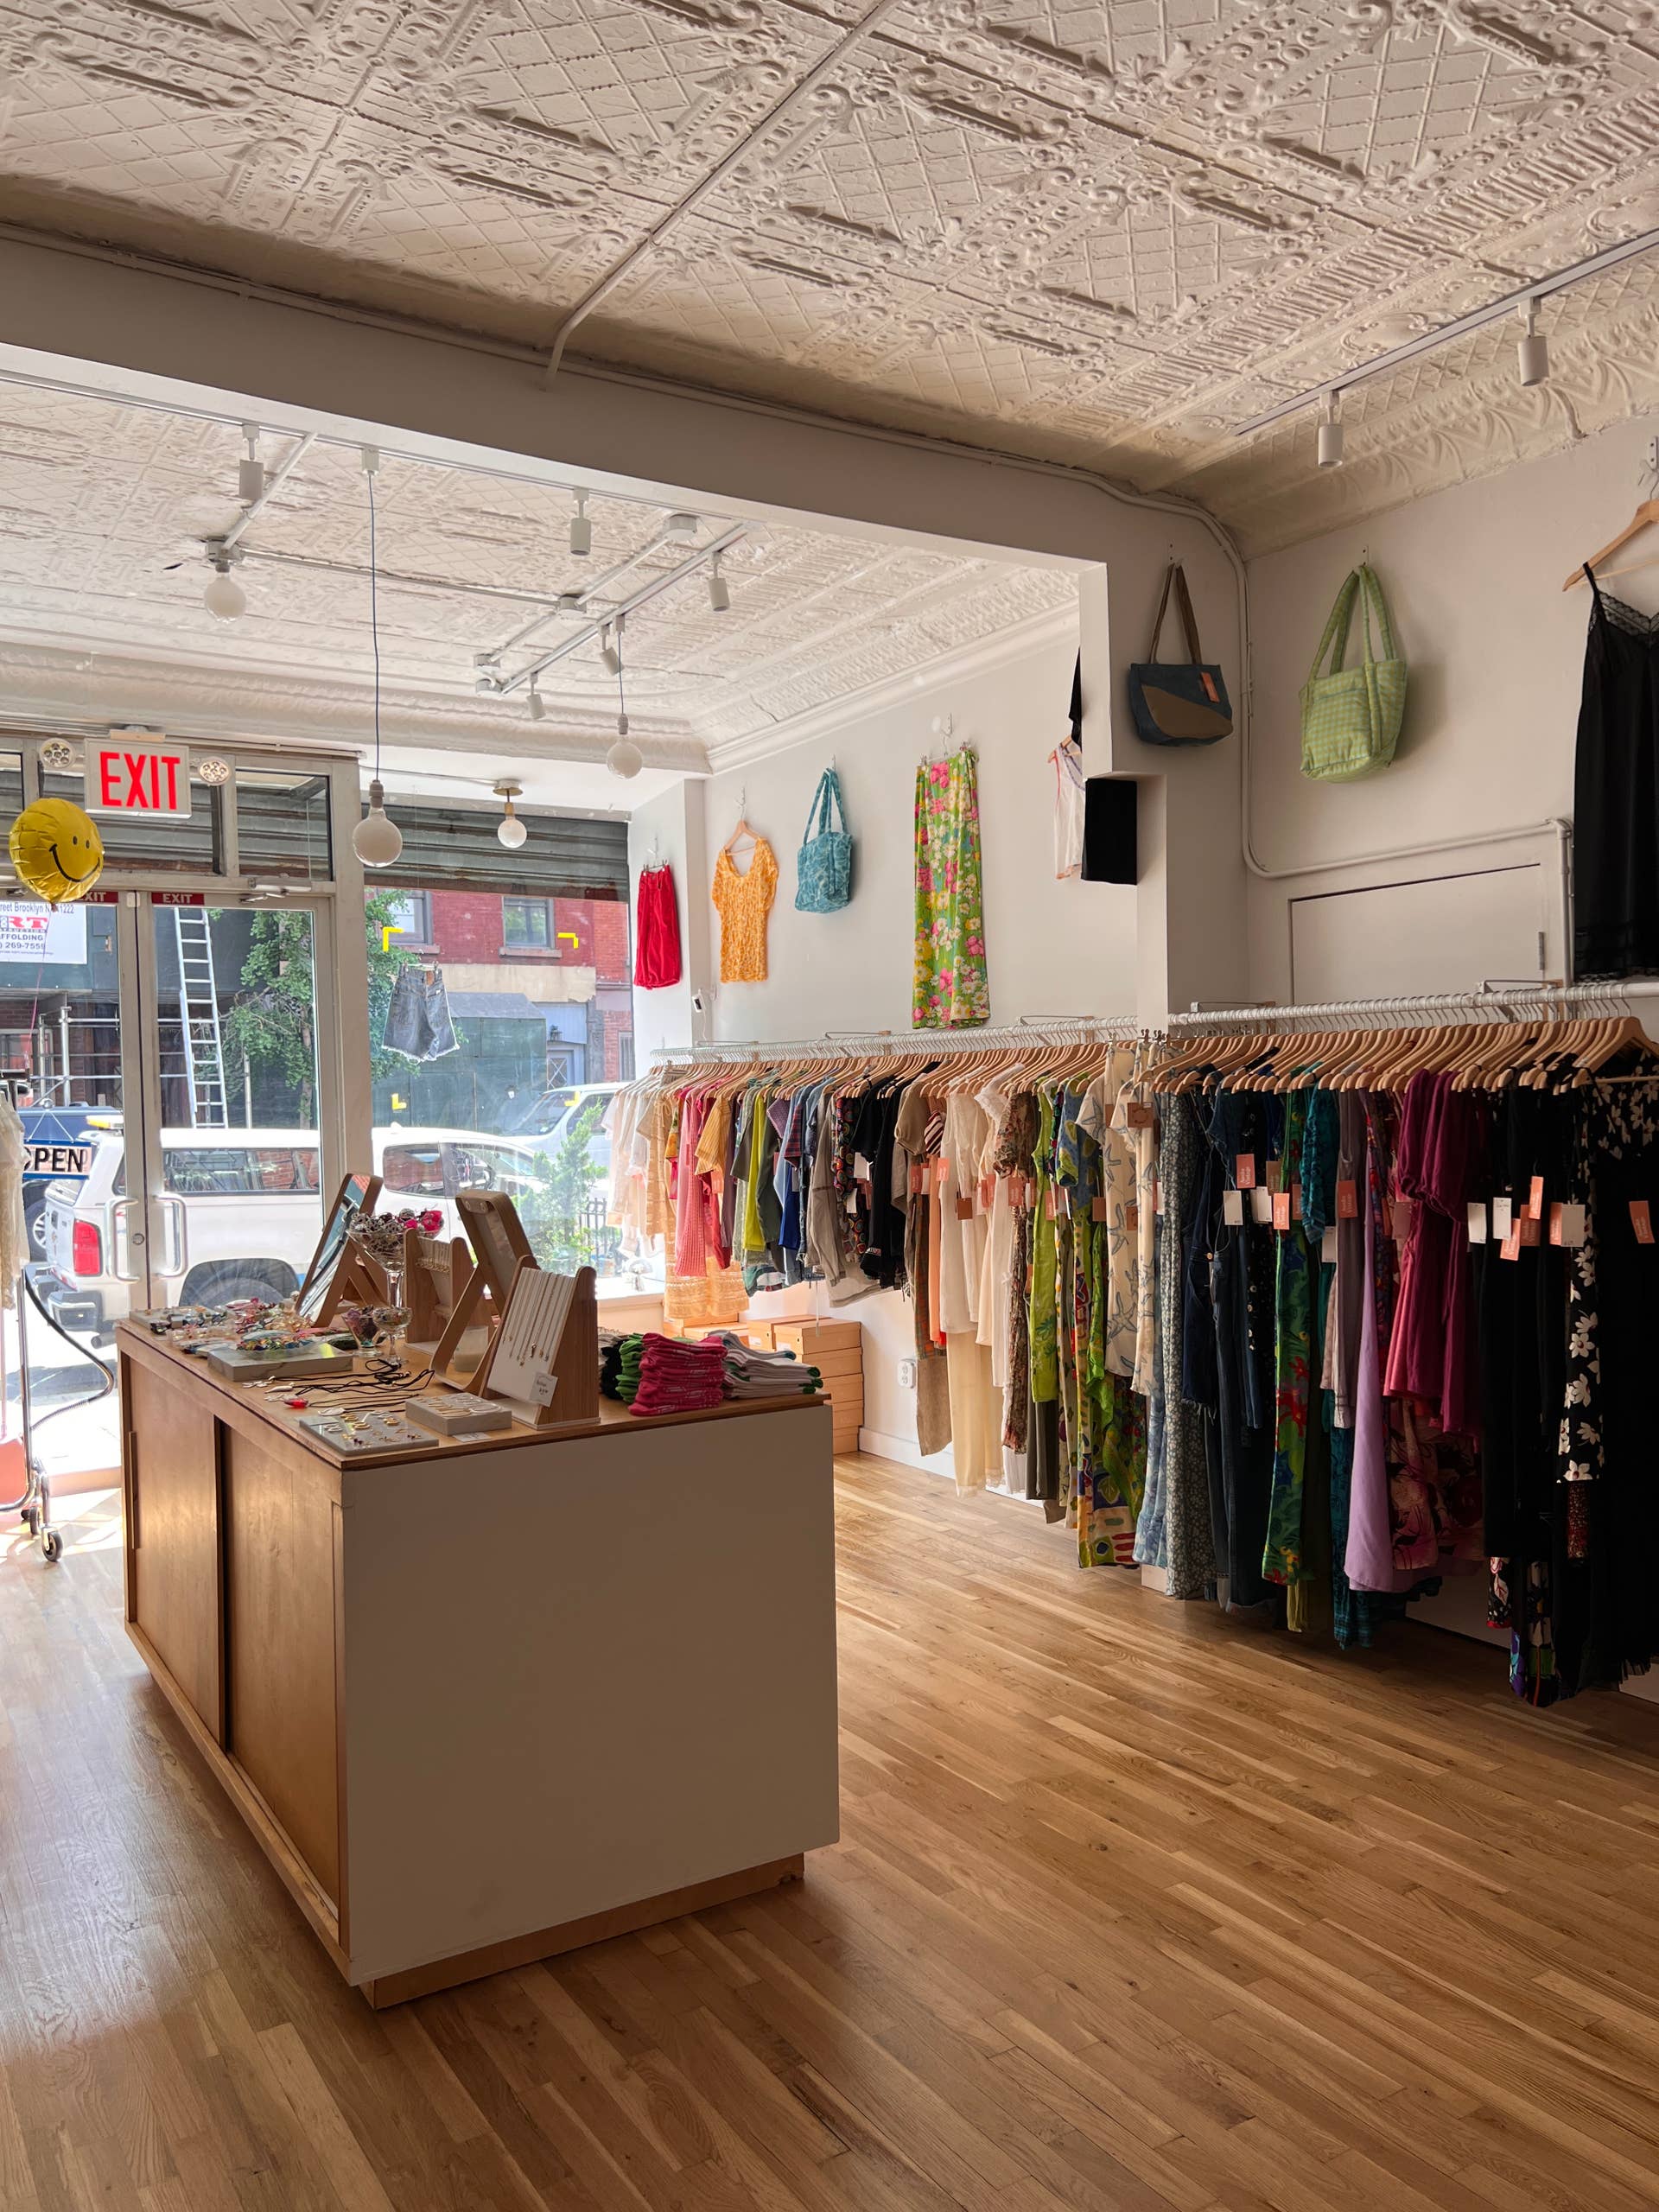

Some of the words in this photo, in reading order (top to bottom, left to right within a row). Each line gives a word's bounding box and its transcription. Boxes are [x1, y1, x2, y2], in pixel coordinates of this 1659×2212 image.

[99, 751, 181, 810] EXIT
[78, 891, 106, 902] XIT
[162, 893, 193, 904] EXIT
[14, 902, 44, 915] Brooklyn
